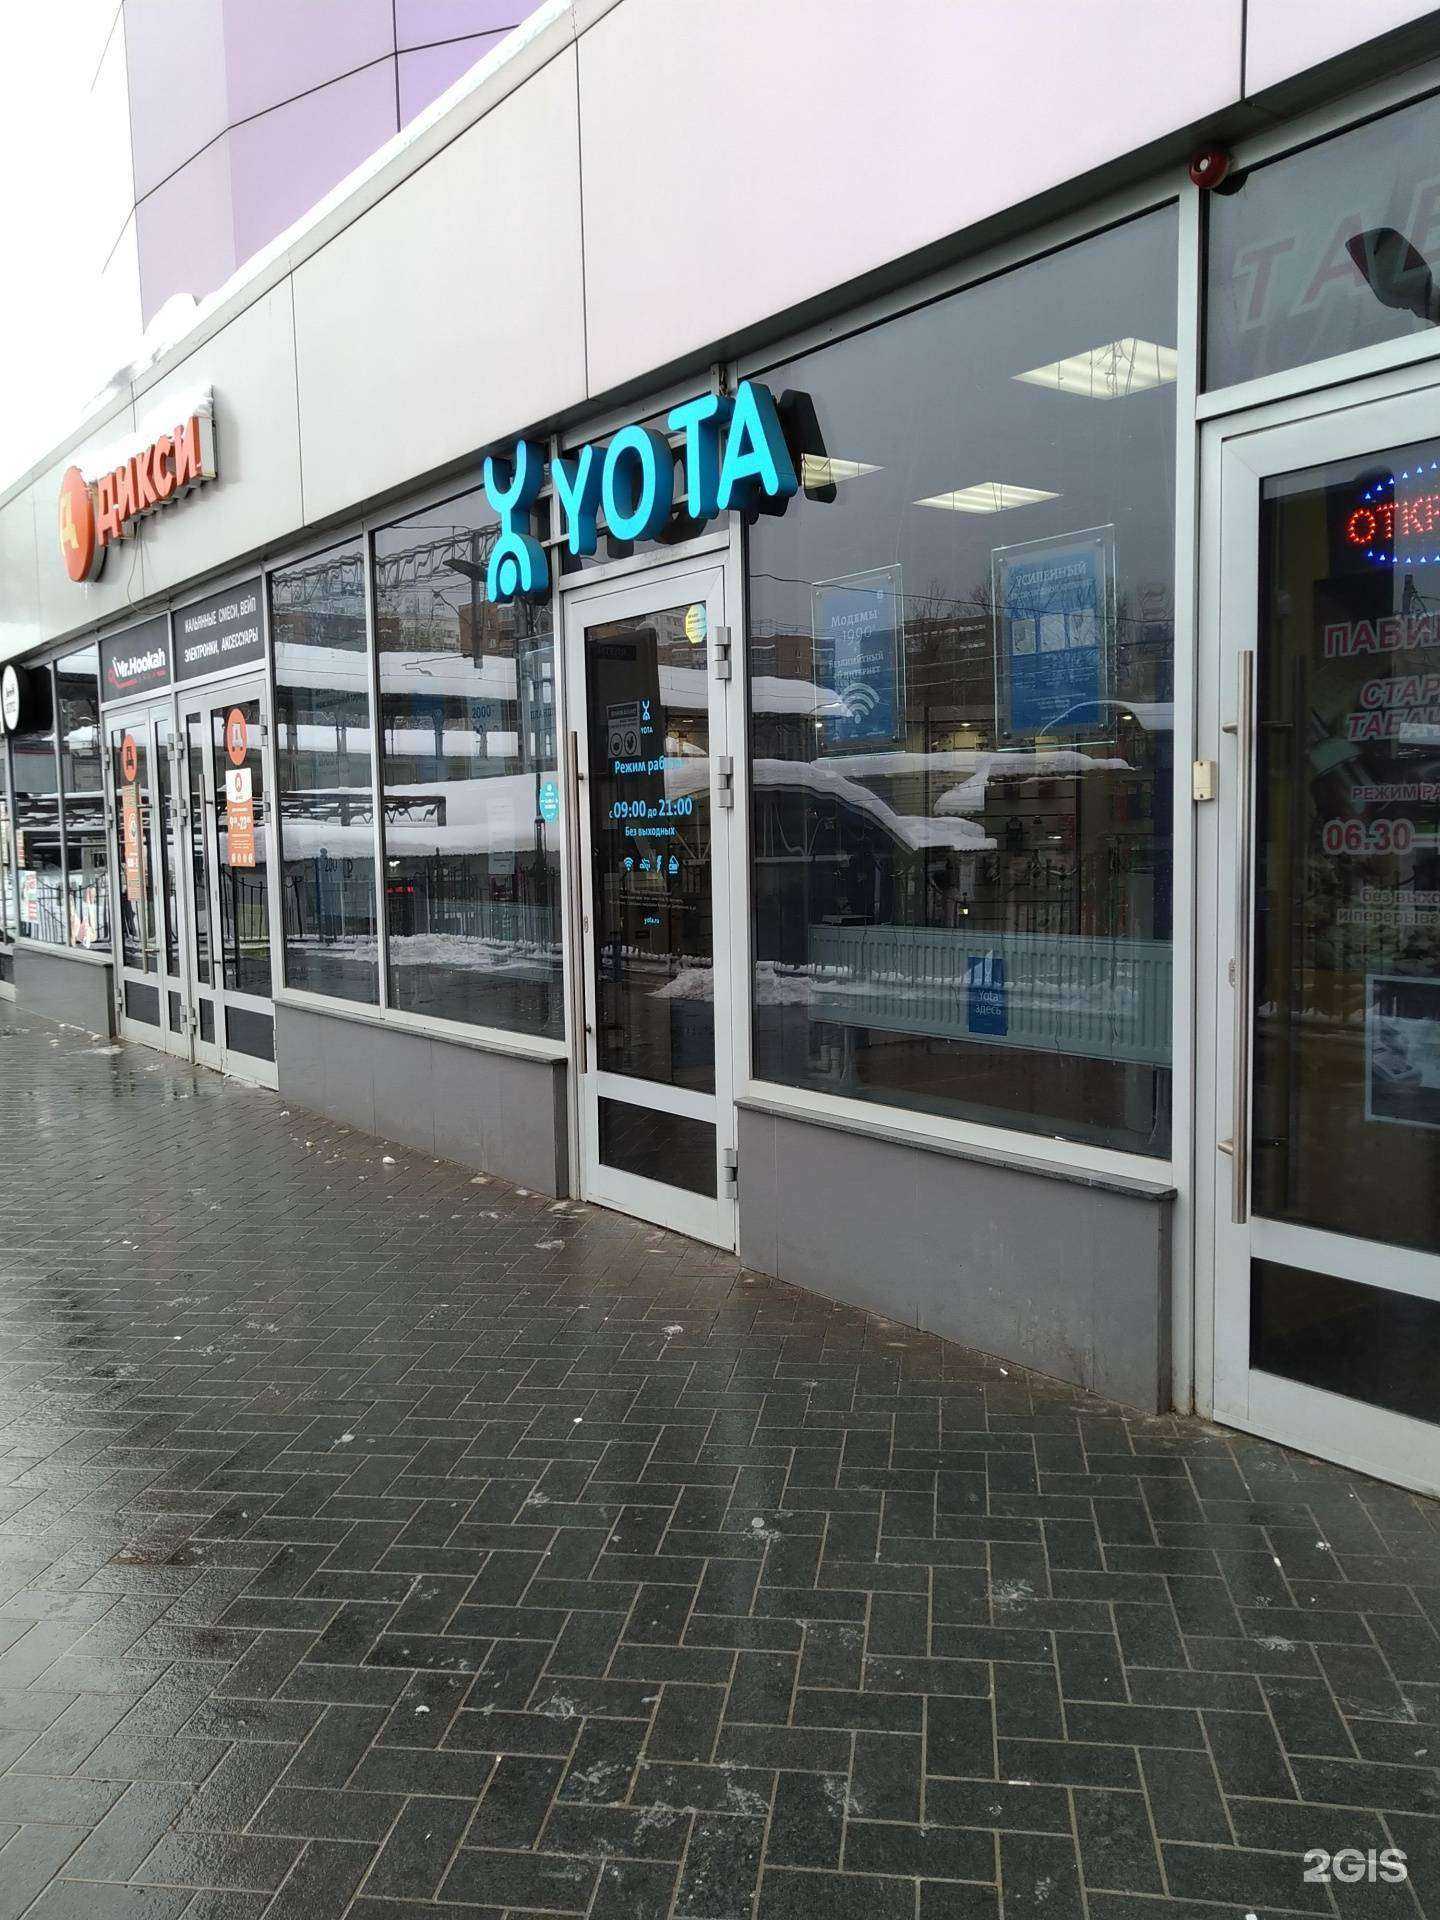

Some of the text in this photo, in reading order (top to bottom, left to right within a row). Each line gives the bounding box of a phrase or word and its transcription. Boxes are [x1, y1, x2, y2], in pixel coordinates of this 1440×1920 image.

[551, 380, 780, 556] YOTA
[98, 415, 201, 547] ДИКСИ
[184, 610, 217, 634] КАЛЬЯННЫЕ
[221, 627, 259, 651] АКСЕССУАРЫ
[1325, 614, 1440, 658] ПАВИ
[614, 760, 646, 774] Режим
[1351, 785, 1417, 801] РЕЖИМ
[613, 800, 647, 819] 09:00
[647, 808, 658, 819] до
[658, 796, 693, 817] 21:00
[625, 826, 676, 838] Без выходных
[979, 990, 999, 1002] Yota
[975, 1004, 1002, 1016] здесь
